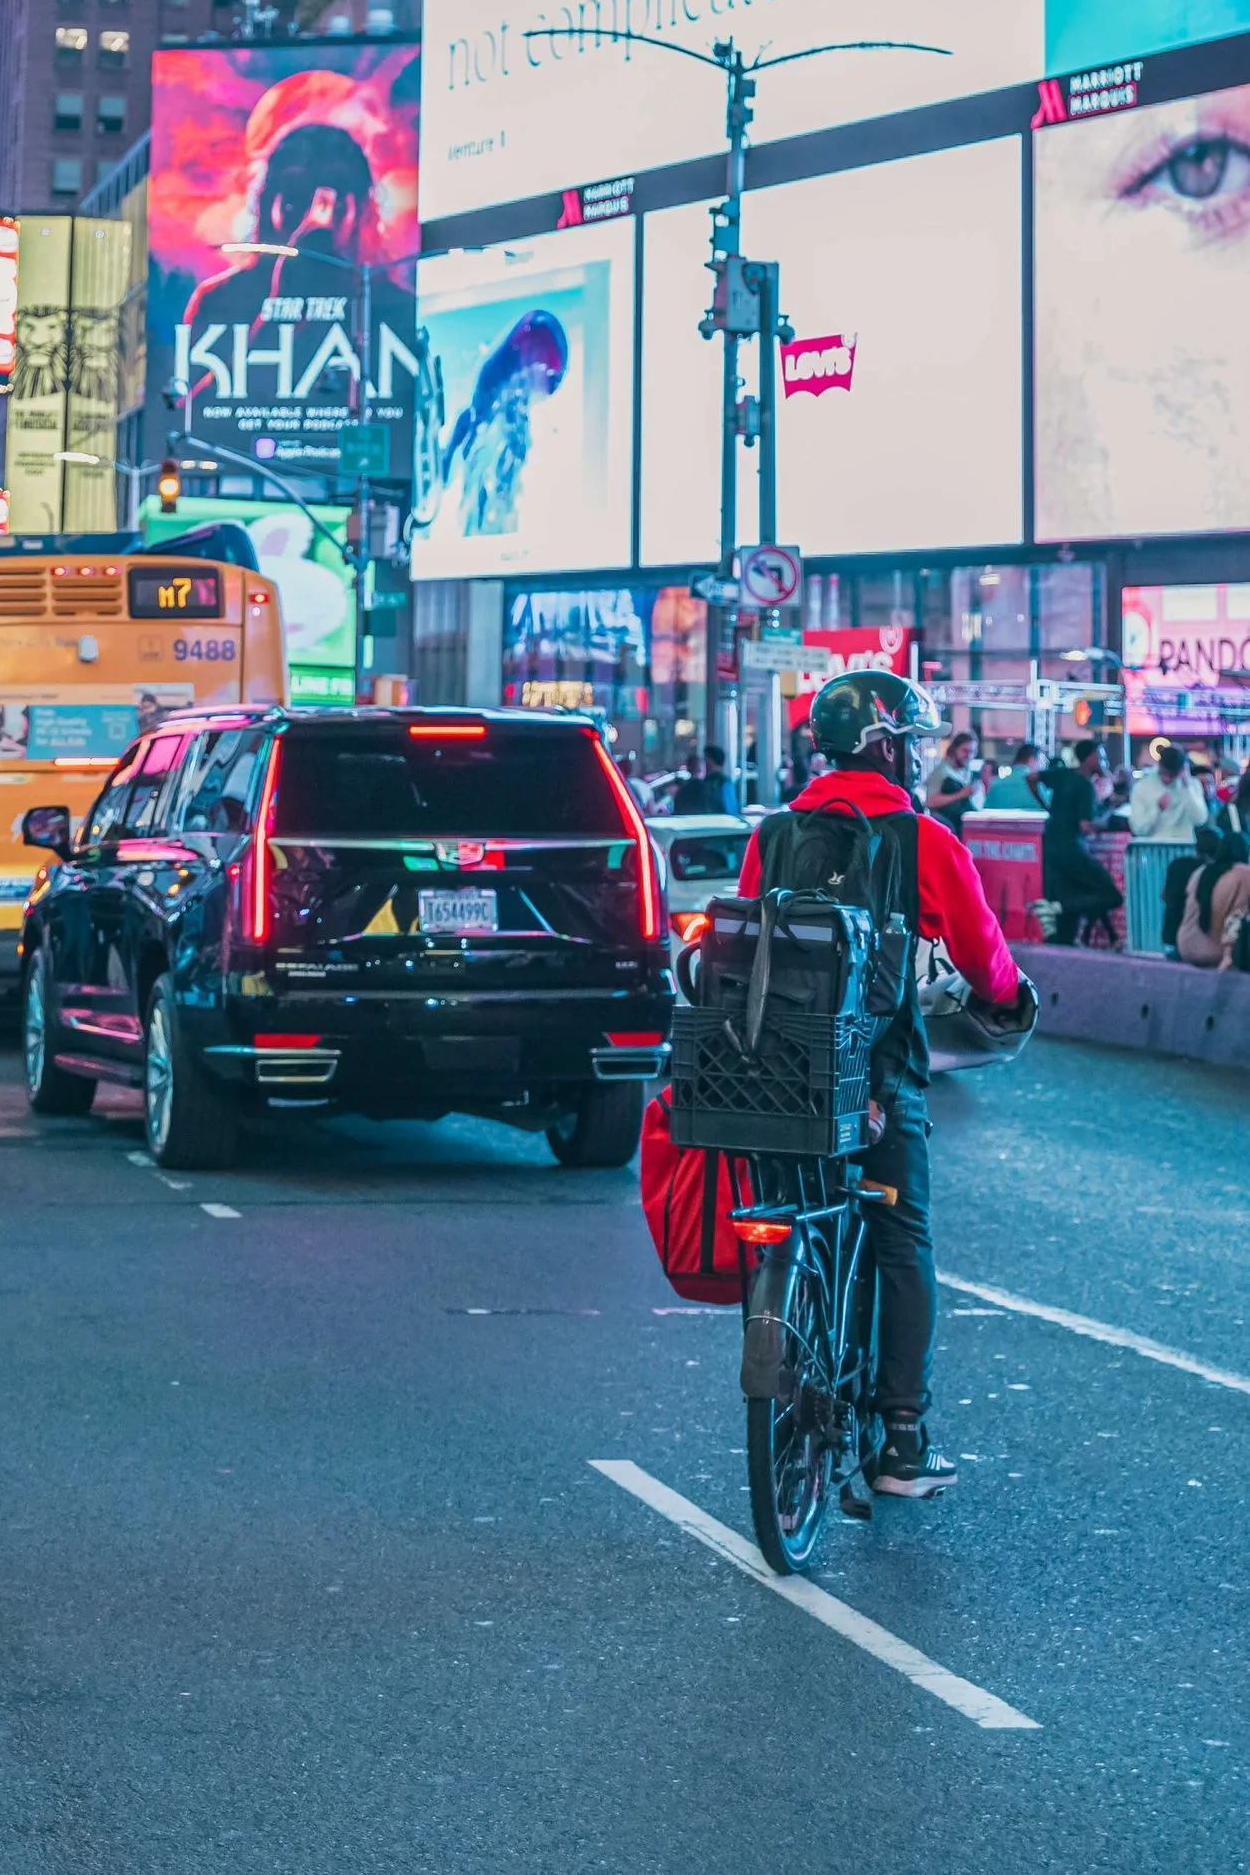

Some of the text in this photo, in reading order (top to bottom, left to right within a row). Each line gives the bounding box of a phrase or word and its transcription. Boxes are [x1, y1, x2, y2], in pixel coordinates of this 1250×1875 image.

[449, 19, 510, 90] not
[1069, 61, 1143, 96] MARRIOTT
[260, 296, 348, 322] STAR TREK
[174, 322, 419, 399] KHAN
[172, 638, 236, 661] 9488
